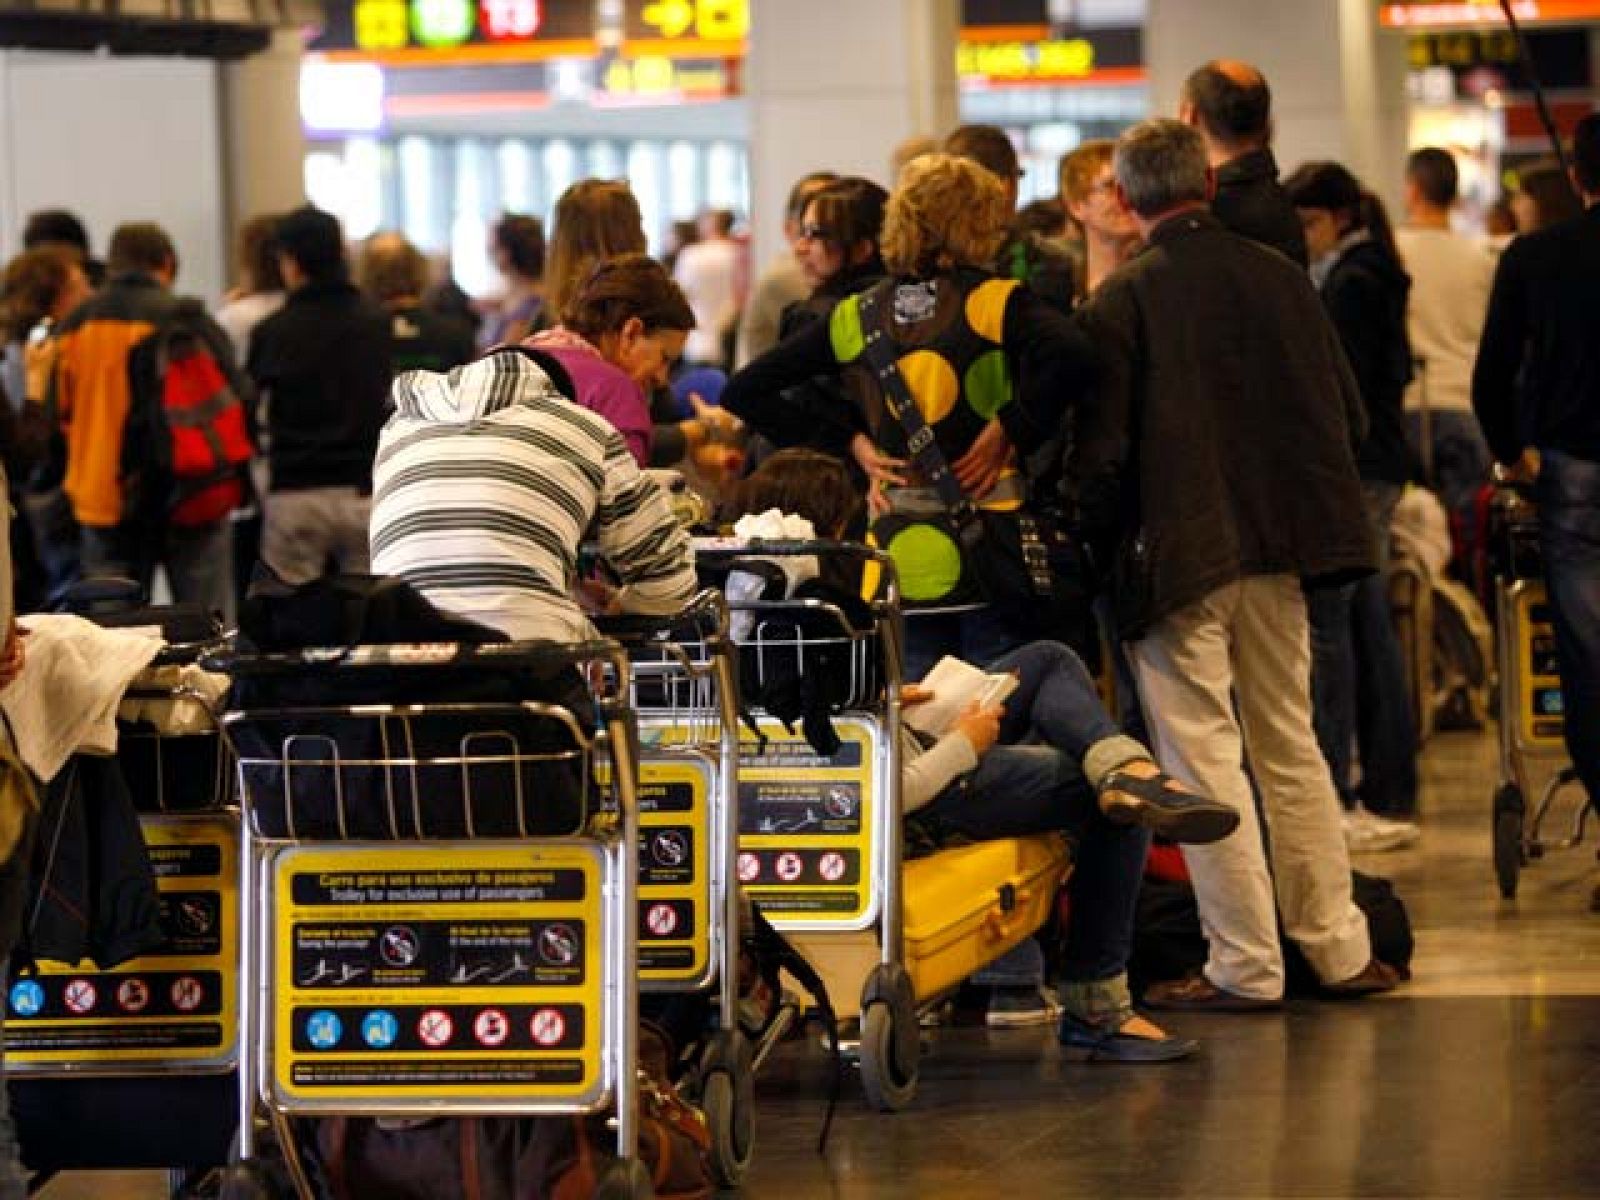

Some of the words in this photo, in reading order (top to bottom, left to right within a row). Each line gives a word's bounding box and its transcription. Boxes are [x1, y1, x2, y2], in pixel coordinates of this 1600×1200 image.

[357, 873, 386, 889] para
[387, 886, 438, 900] exclusive
[440, 887, 461, 900] use
[464, 886, 476, 900] of
